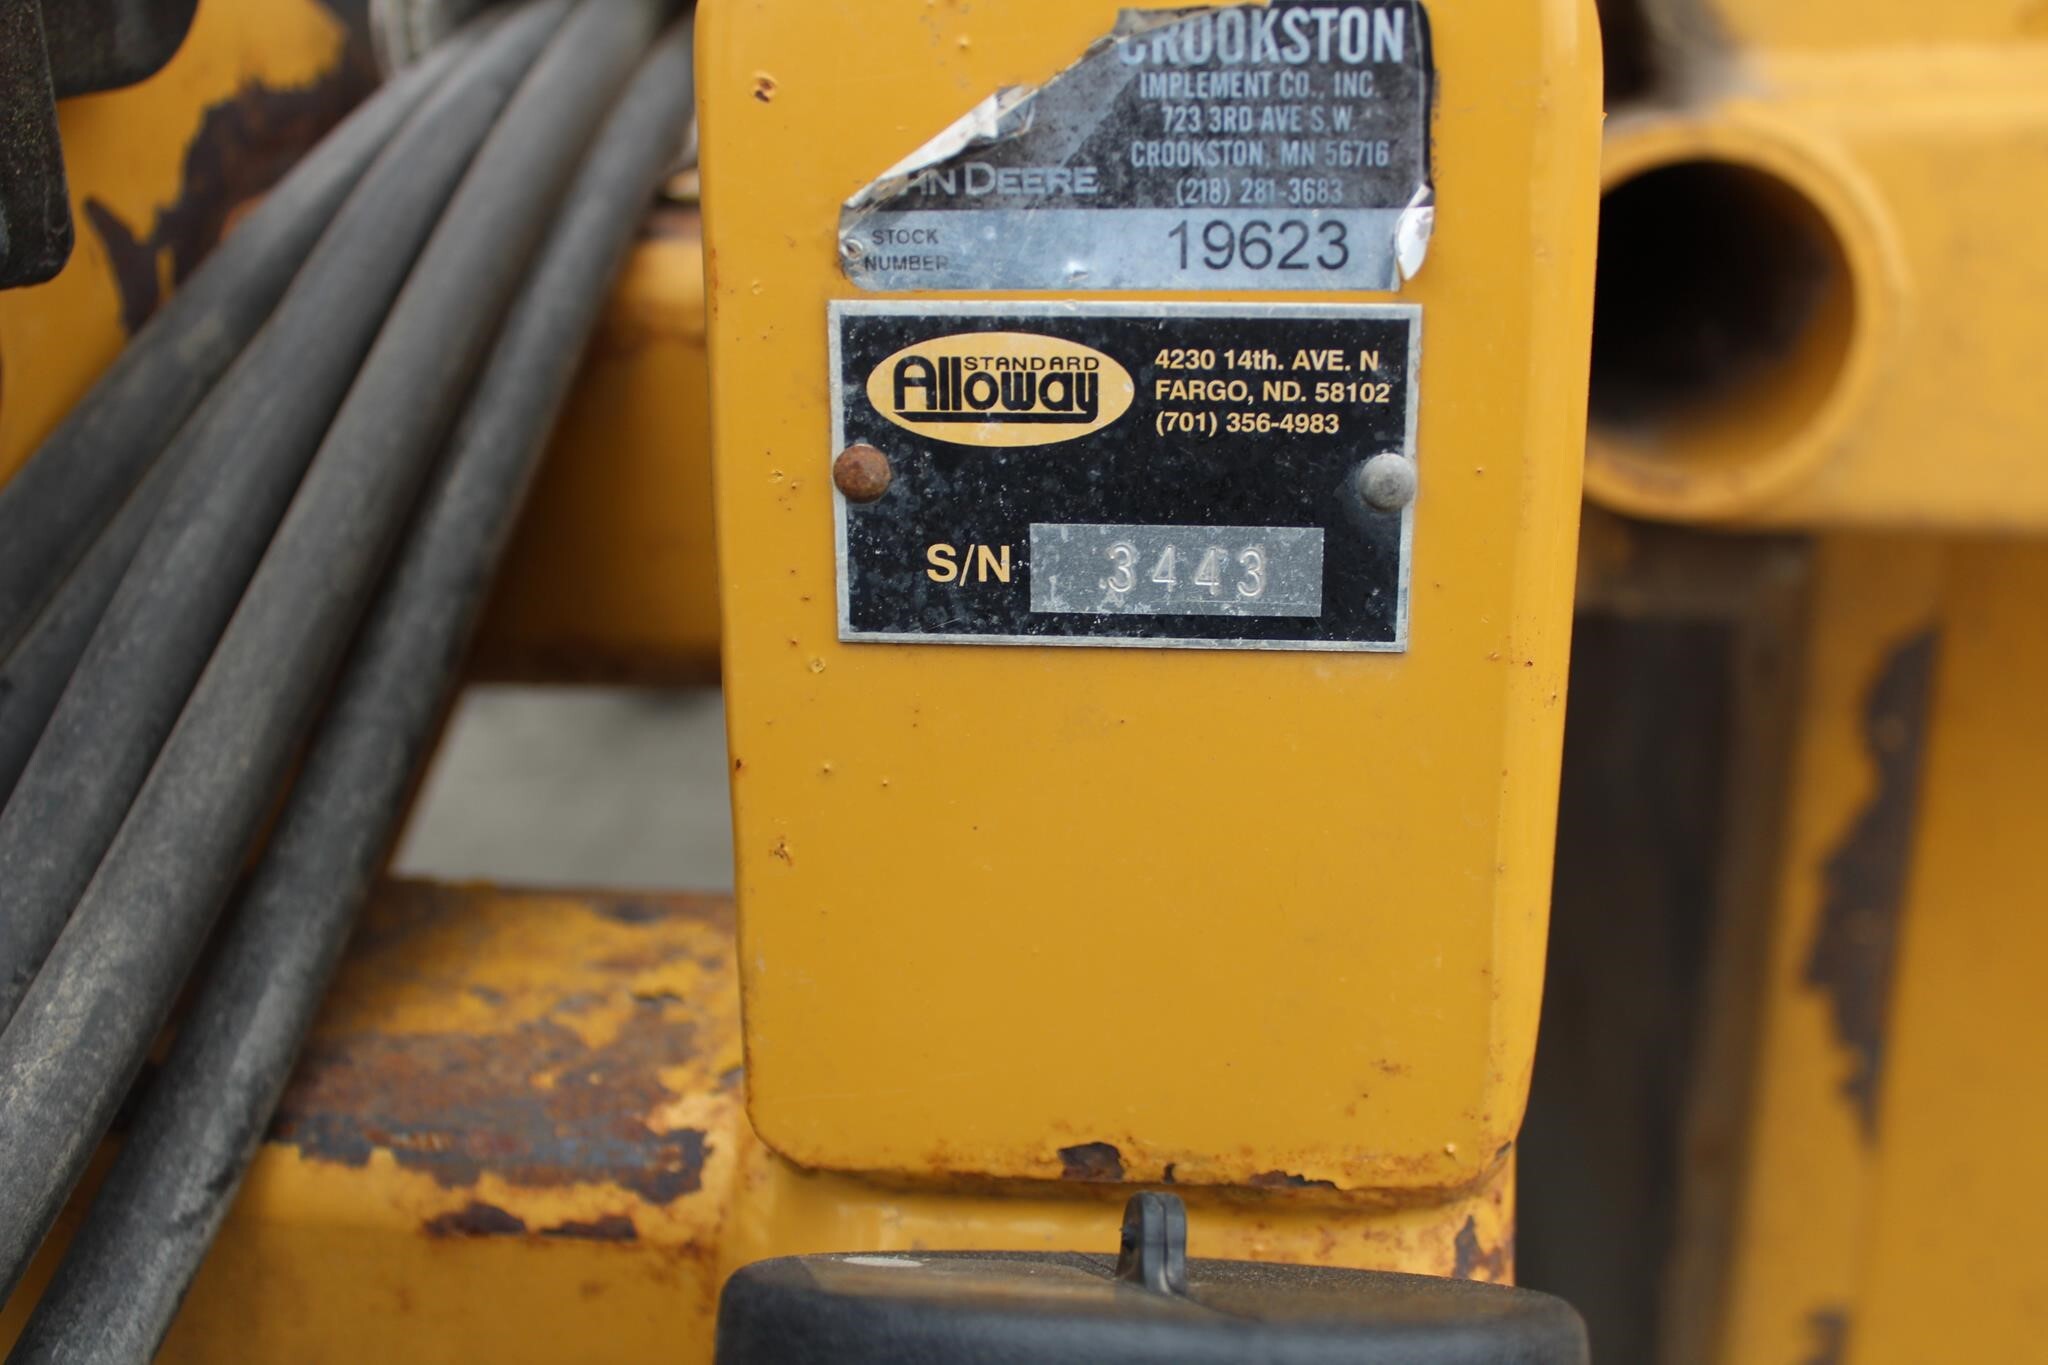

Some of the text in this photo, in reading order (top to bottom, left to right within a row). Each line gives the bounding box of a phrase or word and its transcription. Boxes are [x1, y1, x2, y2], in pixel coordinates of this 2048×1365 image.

[1140, 70, 1273, 99] IMPLEMENT
[1161, 105, 1201, 133] 723
[1208, 106, 1252, 133] 3RD
[1260, 105, 1302, 132] AVE
[1280, 142, 1315, 167] MN
[1325, 140, 1390, 168] 56716
[1175, 177, 1343, 206] (218) 281-3683
[872, 228, 940, 246] STOCK
[1168, 219, 1350, 270] 19623
[864, 254, 948, 273] NUMBER
[963, 356, 1100, 371] STANDARD
[1154, 349, 1380, 371] 4230 14th. AVE. N
[892, 355, 1099, 424] Alloway
[1155, 380, 1391, 406] FARGO, ND. 58102
[1155, 411, 1341, 438] (701) 356-4983
[926, 541, 1267, 598] S/N 3443
